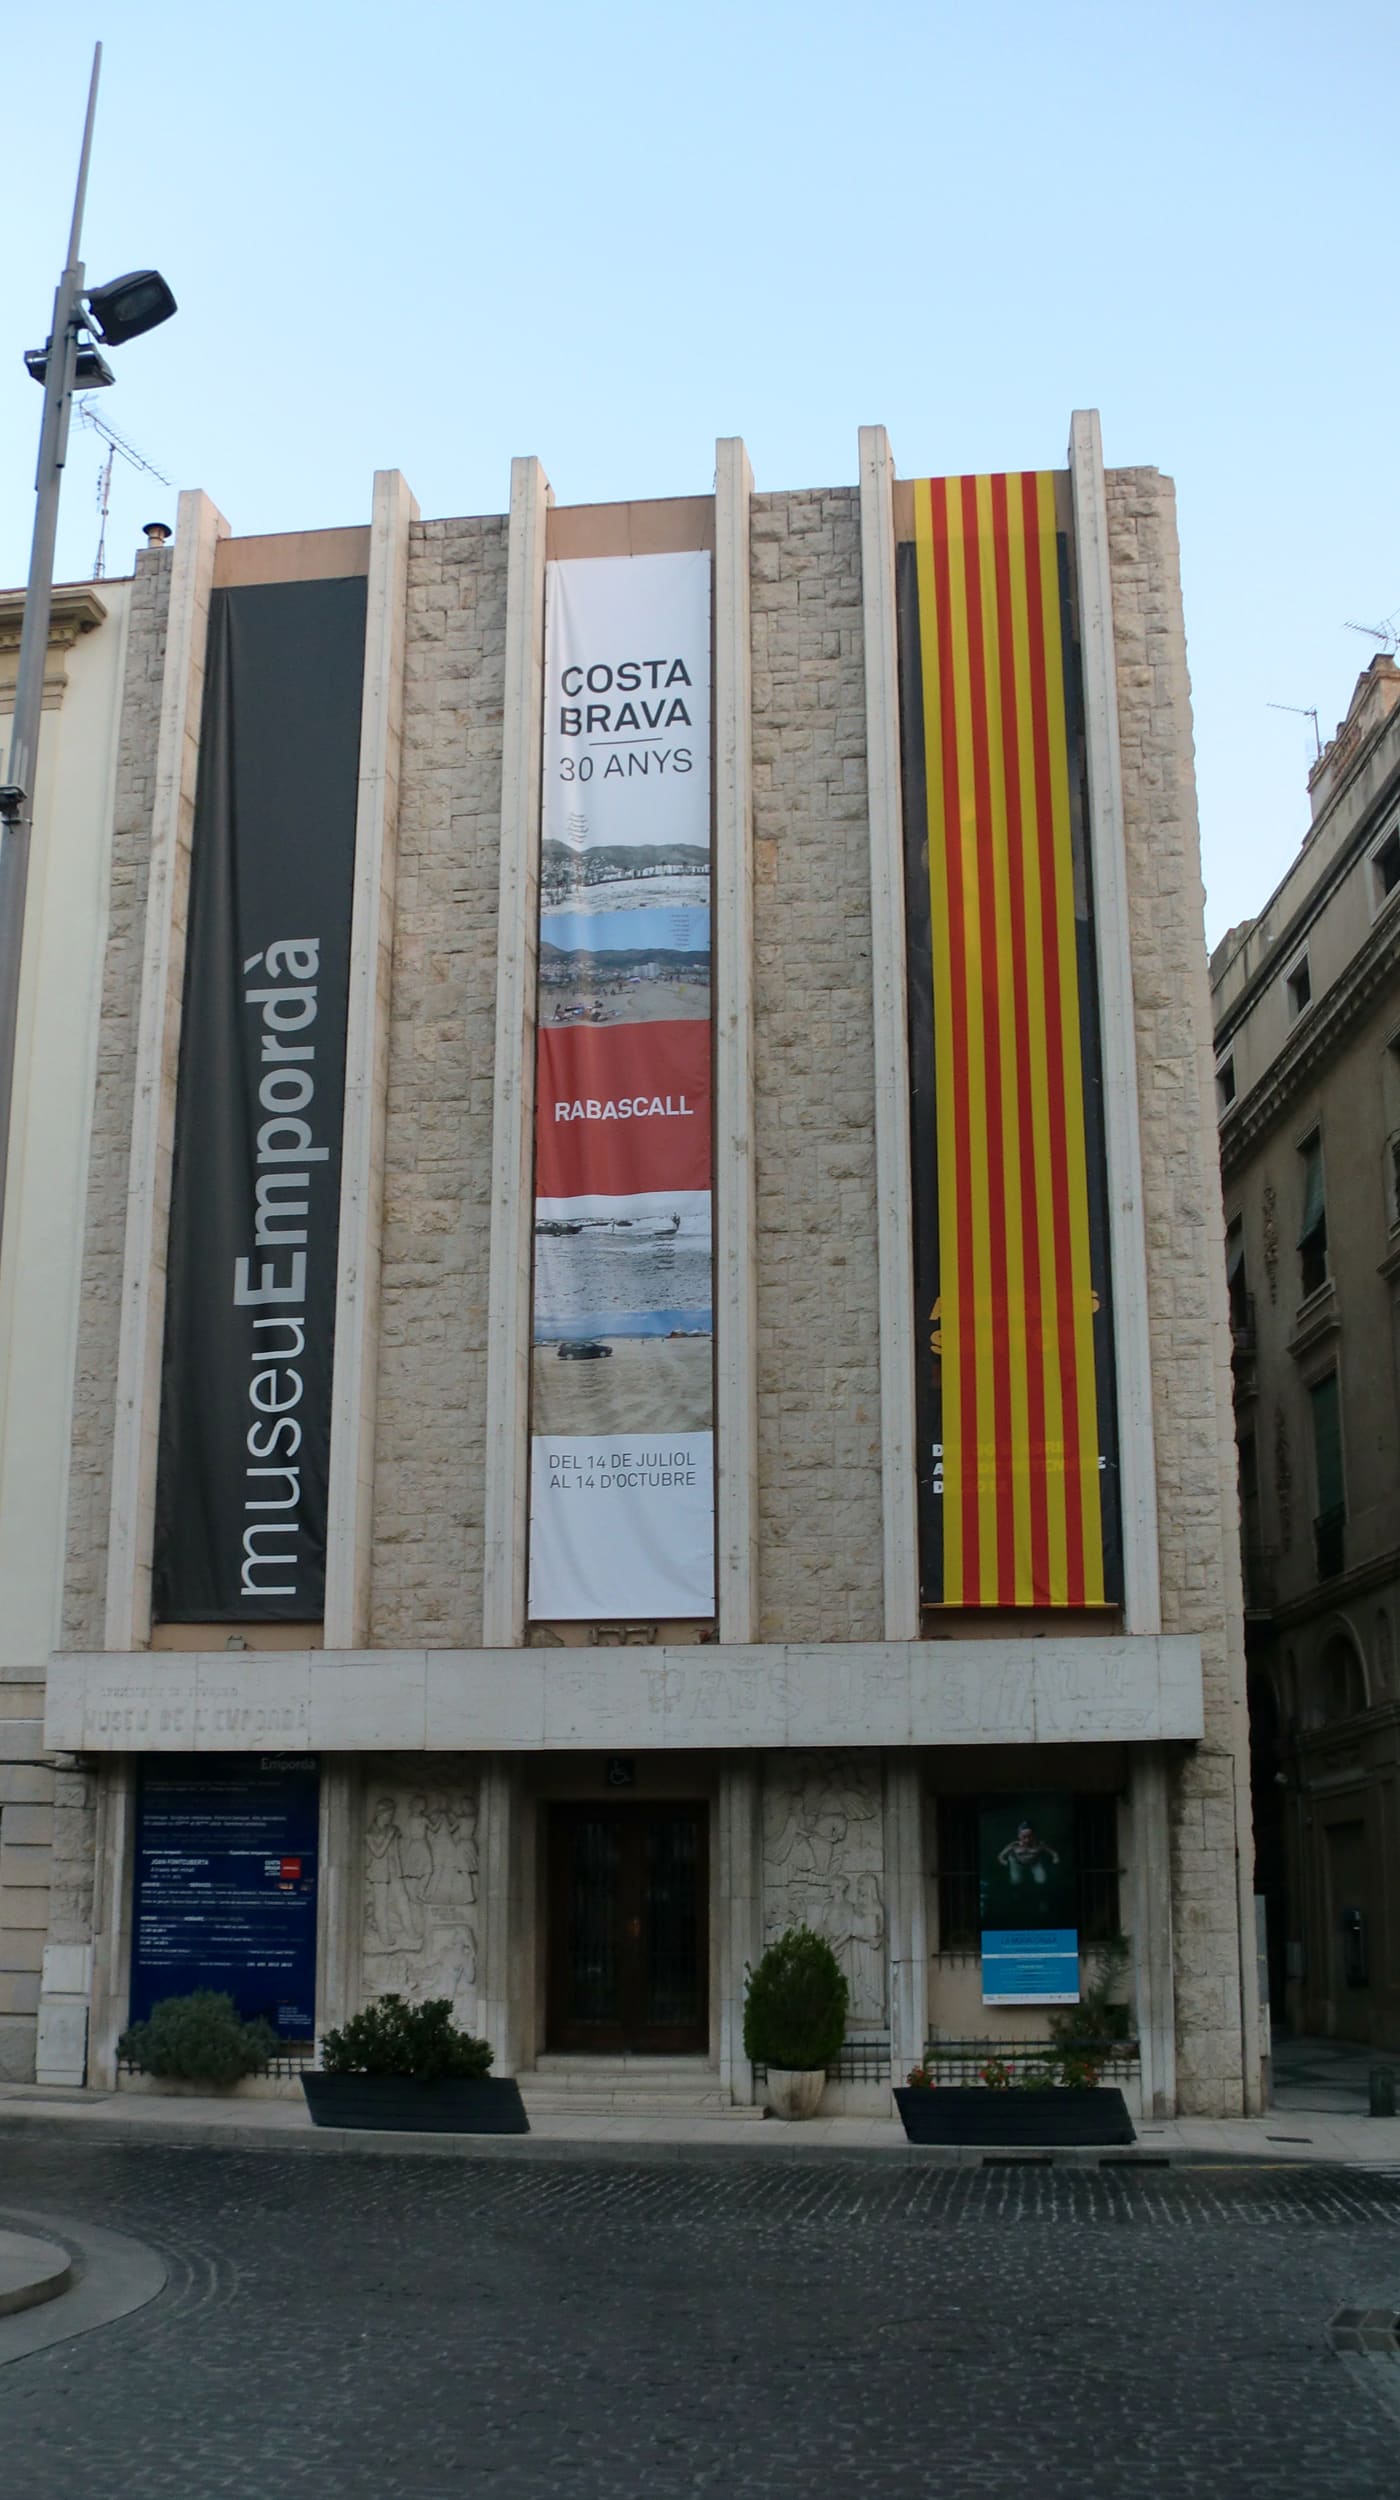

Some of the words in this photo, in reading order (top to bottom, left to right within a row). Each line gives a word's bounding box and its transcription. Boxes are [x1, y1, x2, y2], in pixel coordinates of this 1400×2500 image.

[561, 658, 692, 697] COSTA
[560, 698, 692, 736] BRAVA
[560, 756, 593, 782] 30
[603, 748, 693, 778] ANYS
[554, 1095, 694, 1122] RABASCALL
[549, 1454, 582, 1469] DEL
[587, 1455, 606, 1469] 14
[611, 1453, 632, 1468] DE
[636, 1452, 696, 1468] JULIOL
[550, 1475, 571, 1489] AL
[576, 1474, 595, 1489] 14
[600, 1471, 696, 1489] D'OCTUBRE
[160, 1708, 184, 1731] DE
